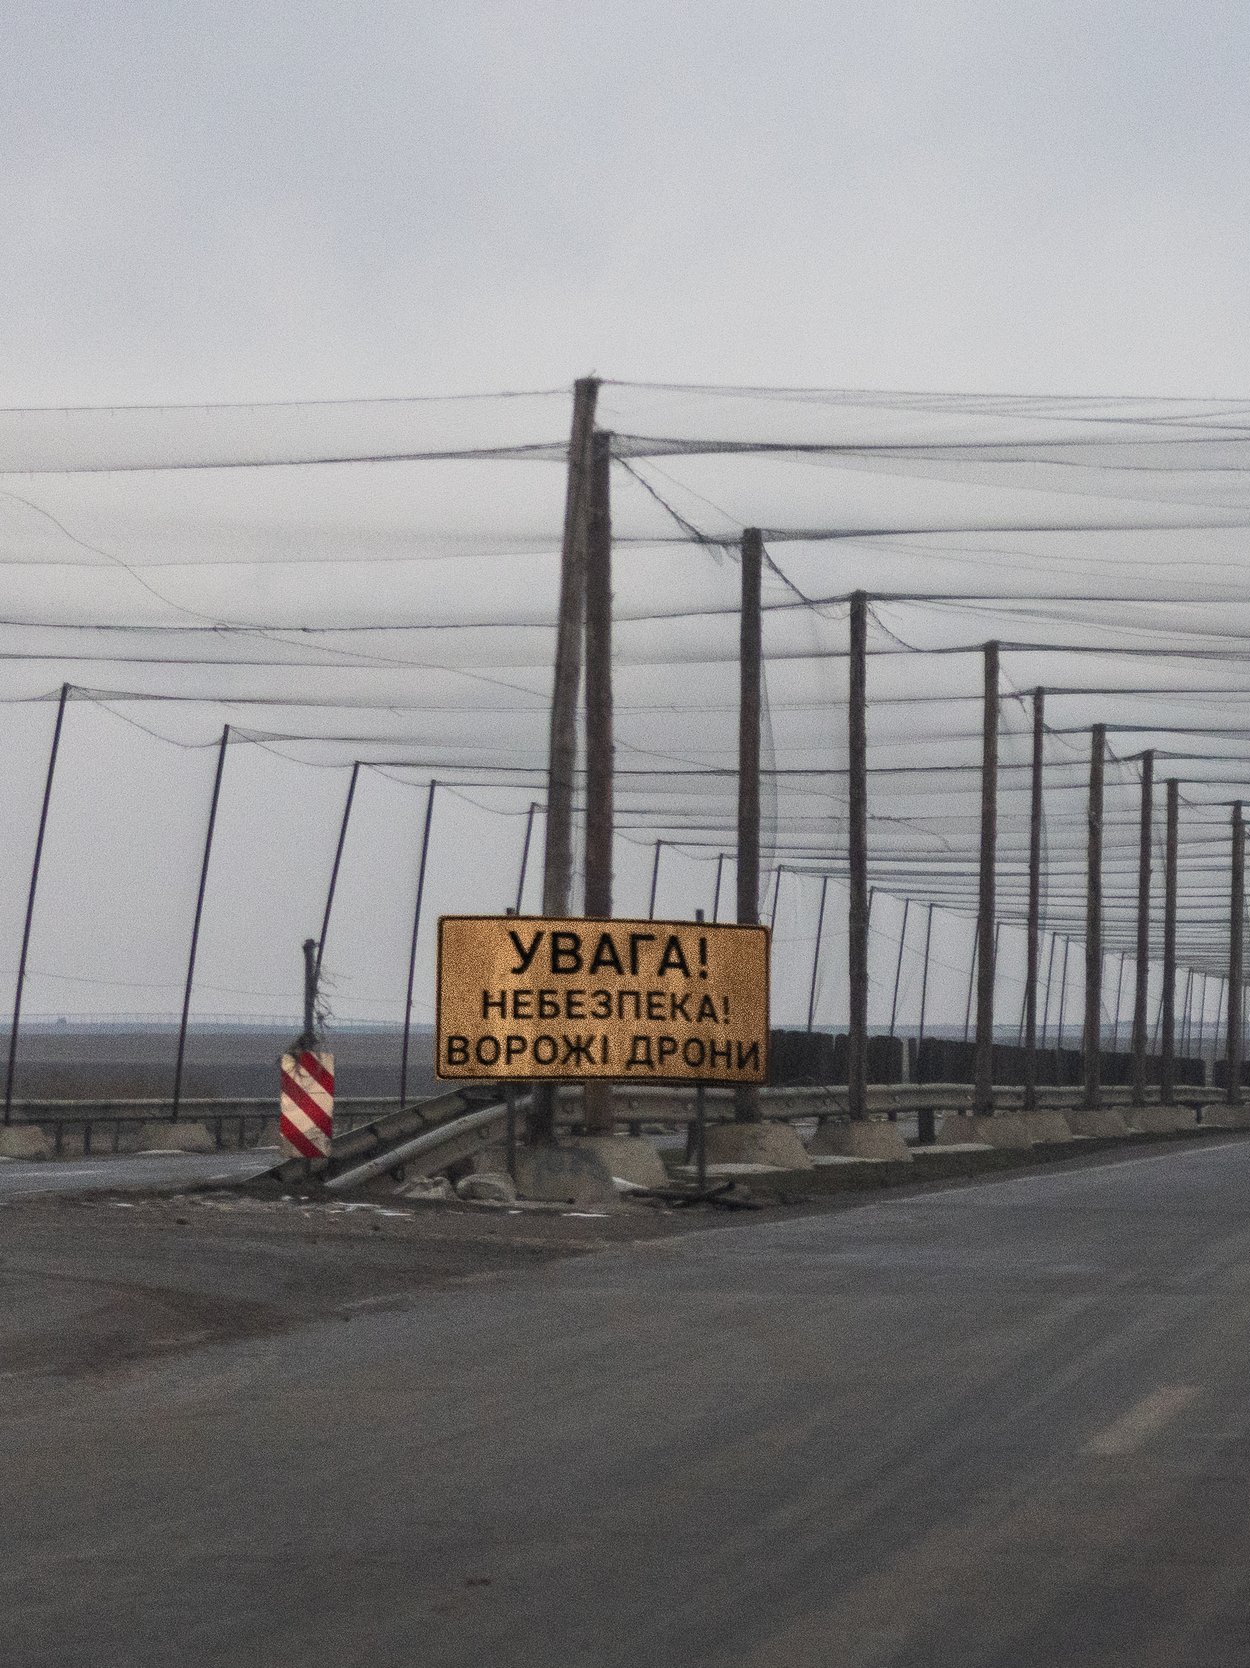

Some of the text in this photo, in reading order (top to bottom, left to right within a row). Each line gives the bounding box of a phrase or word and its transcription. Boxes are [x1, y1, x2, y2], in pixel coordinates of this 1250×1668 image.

[509, 930, 708, 979] УВАГА!
[482, 989, 730, 1024] НЕБЕЗПЕКА!
[447, 1034, 760, 1072] ВОРОЖІ ДРОНИ
